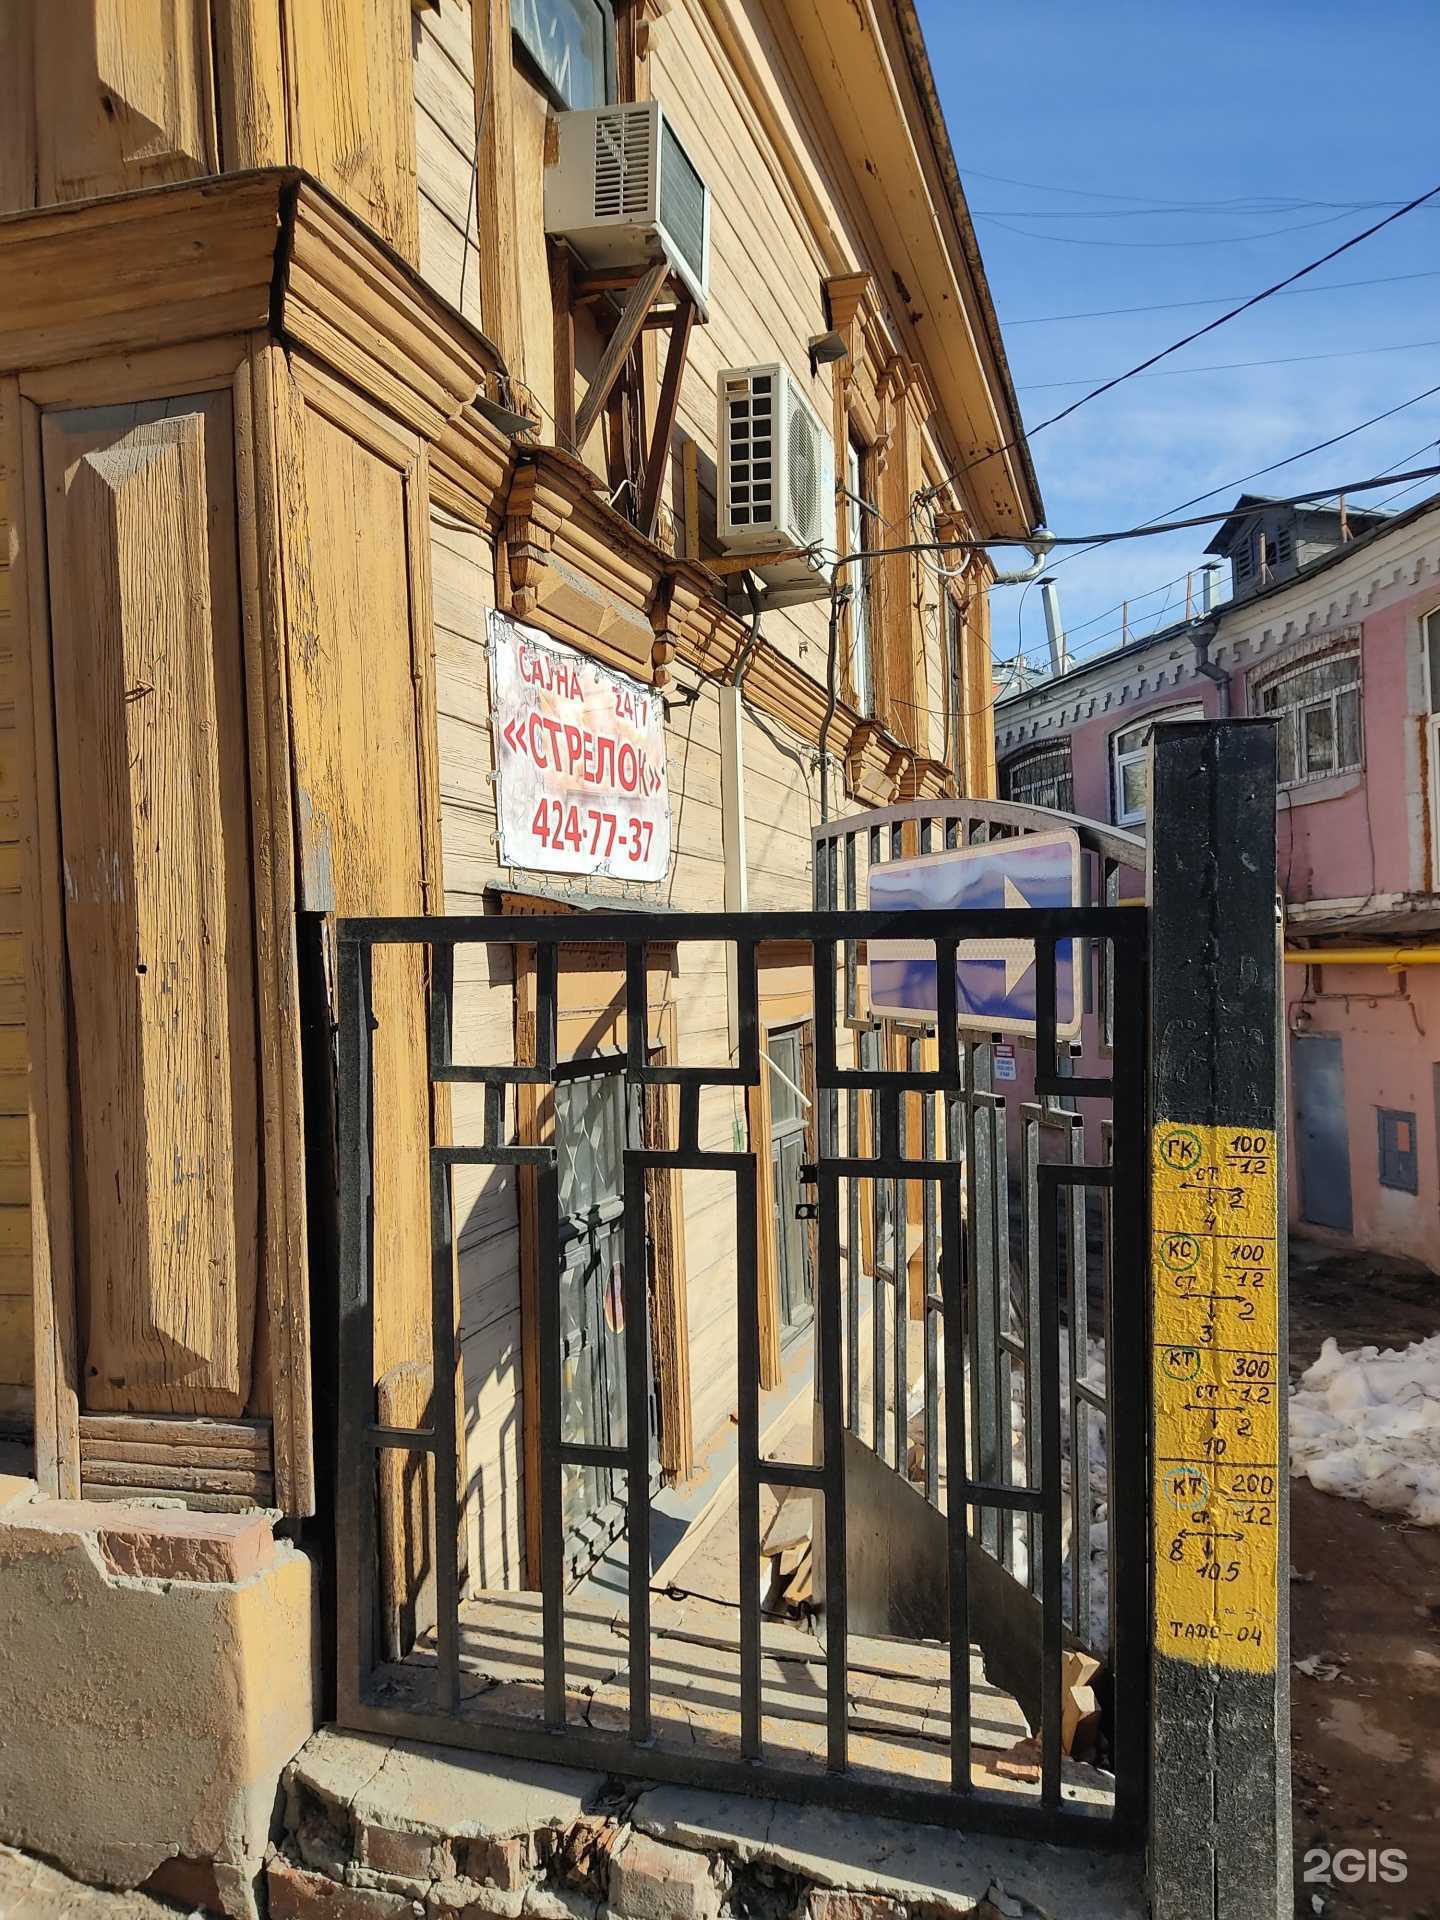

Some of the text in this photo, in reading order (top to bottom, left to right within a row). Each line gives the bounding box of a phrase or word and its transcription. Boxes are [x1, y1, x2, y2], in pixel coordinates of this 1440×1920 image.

[519, 645, 585, 703] САУНА
[1168, 1139, 1193, 1159] ГК
[1230, 1135, 1267, 1153] 100
[1168, 1240, 1192, 1258] КС
[1231, 1244, 1265, 1262] 100
[1238, 1302, 1255, 1321] 2
[1199, 1325, 1214, 1343] 3
[1169, 1351, 1194, 1367] КТ
[1232, 1358, 1270, 1378] 300
[1237, 1417, 1253, 1437] 2
[1203, 1436, 1227, 1456] 10
[1173, 1477, 1202, 1496] КТ
[1232, 1473, 1274, 1494] 200
[1170, 1539, 1184, 1561] 8
[1196, 1561, 1241, 1582] 10.5
